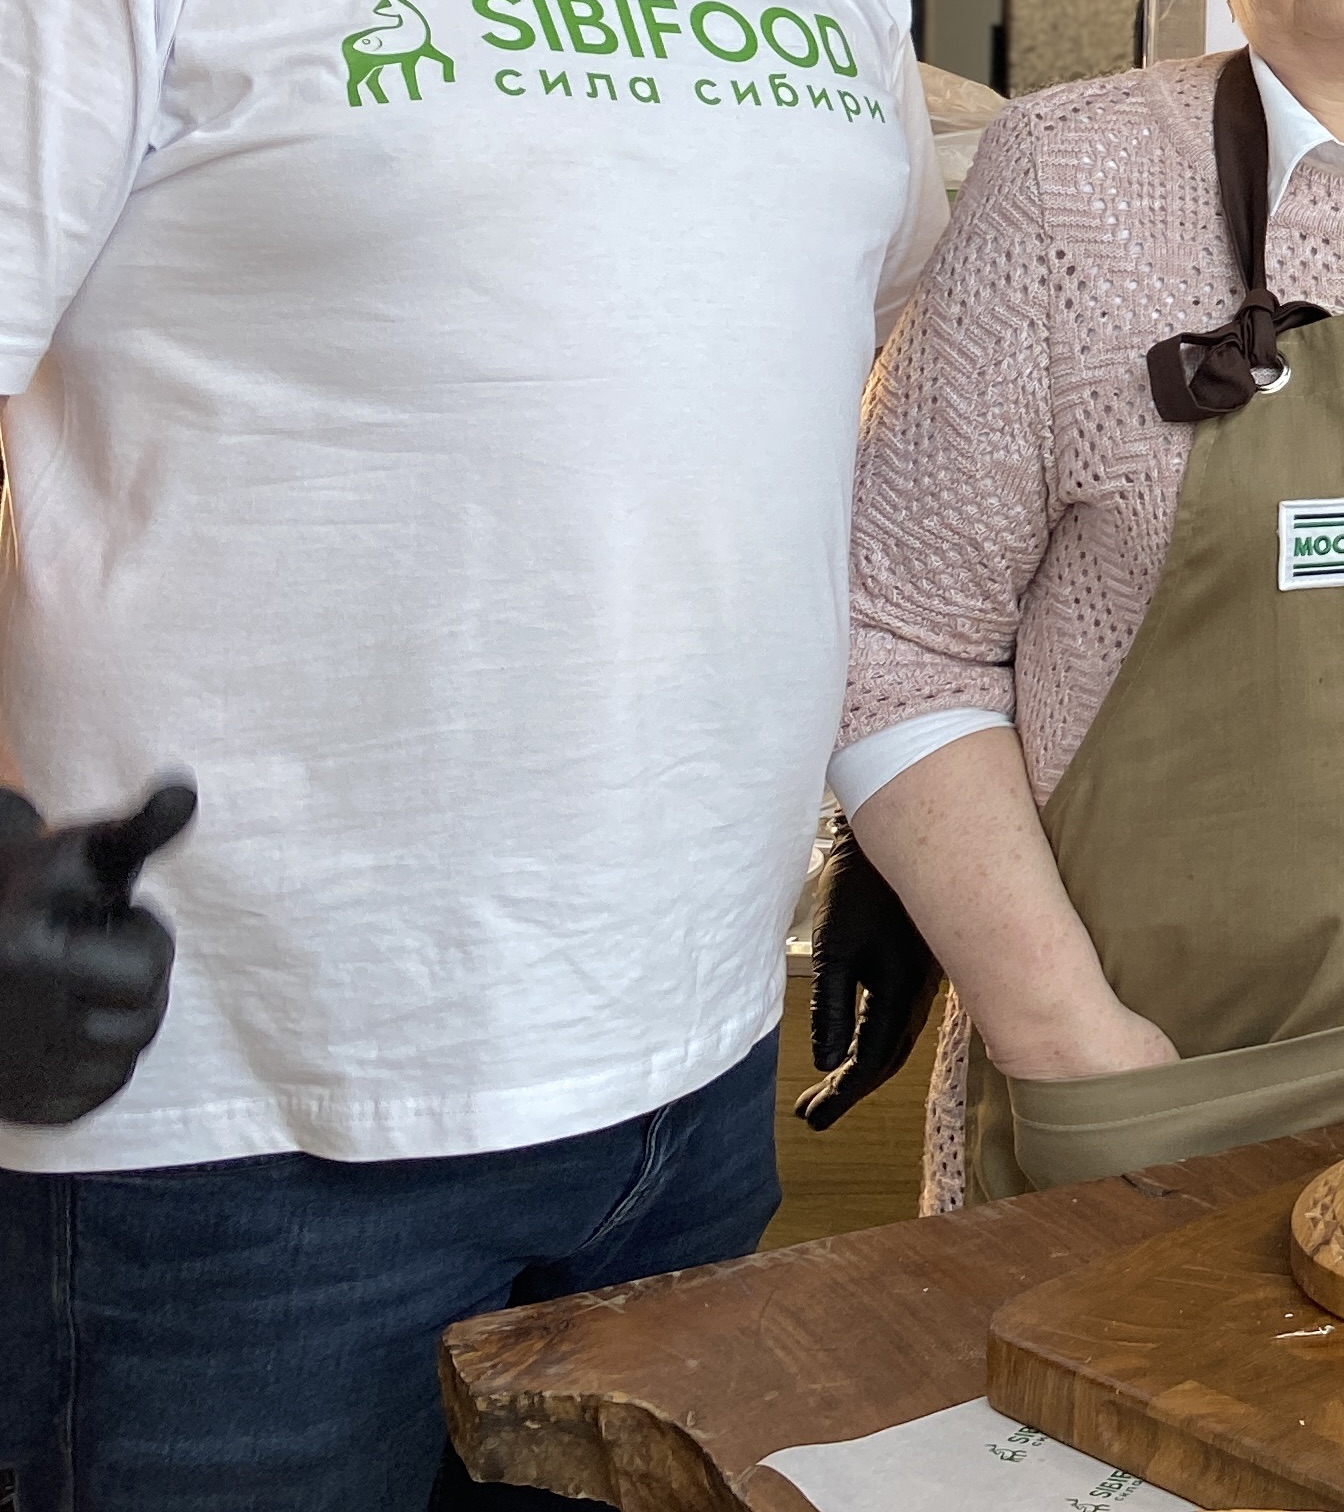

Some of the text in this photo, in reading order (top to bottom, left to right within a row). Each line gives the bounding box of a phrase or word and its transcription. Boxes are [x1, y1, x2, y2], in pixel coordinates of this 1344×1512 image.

[494, 69, 886, 123] сила сибири
[1089, 1470, 1132, 1499] SIBIF
